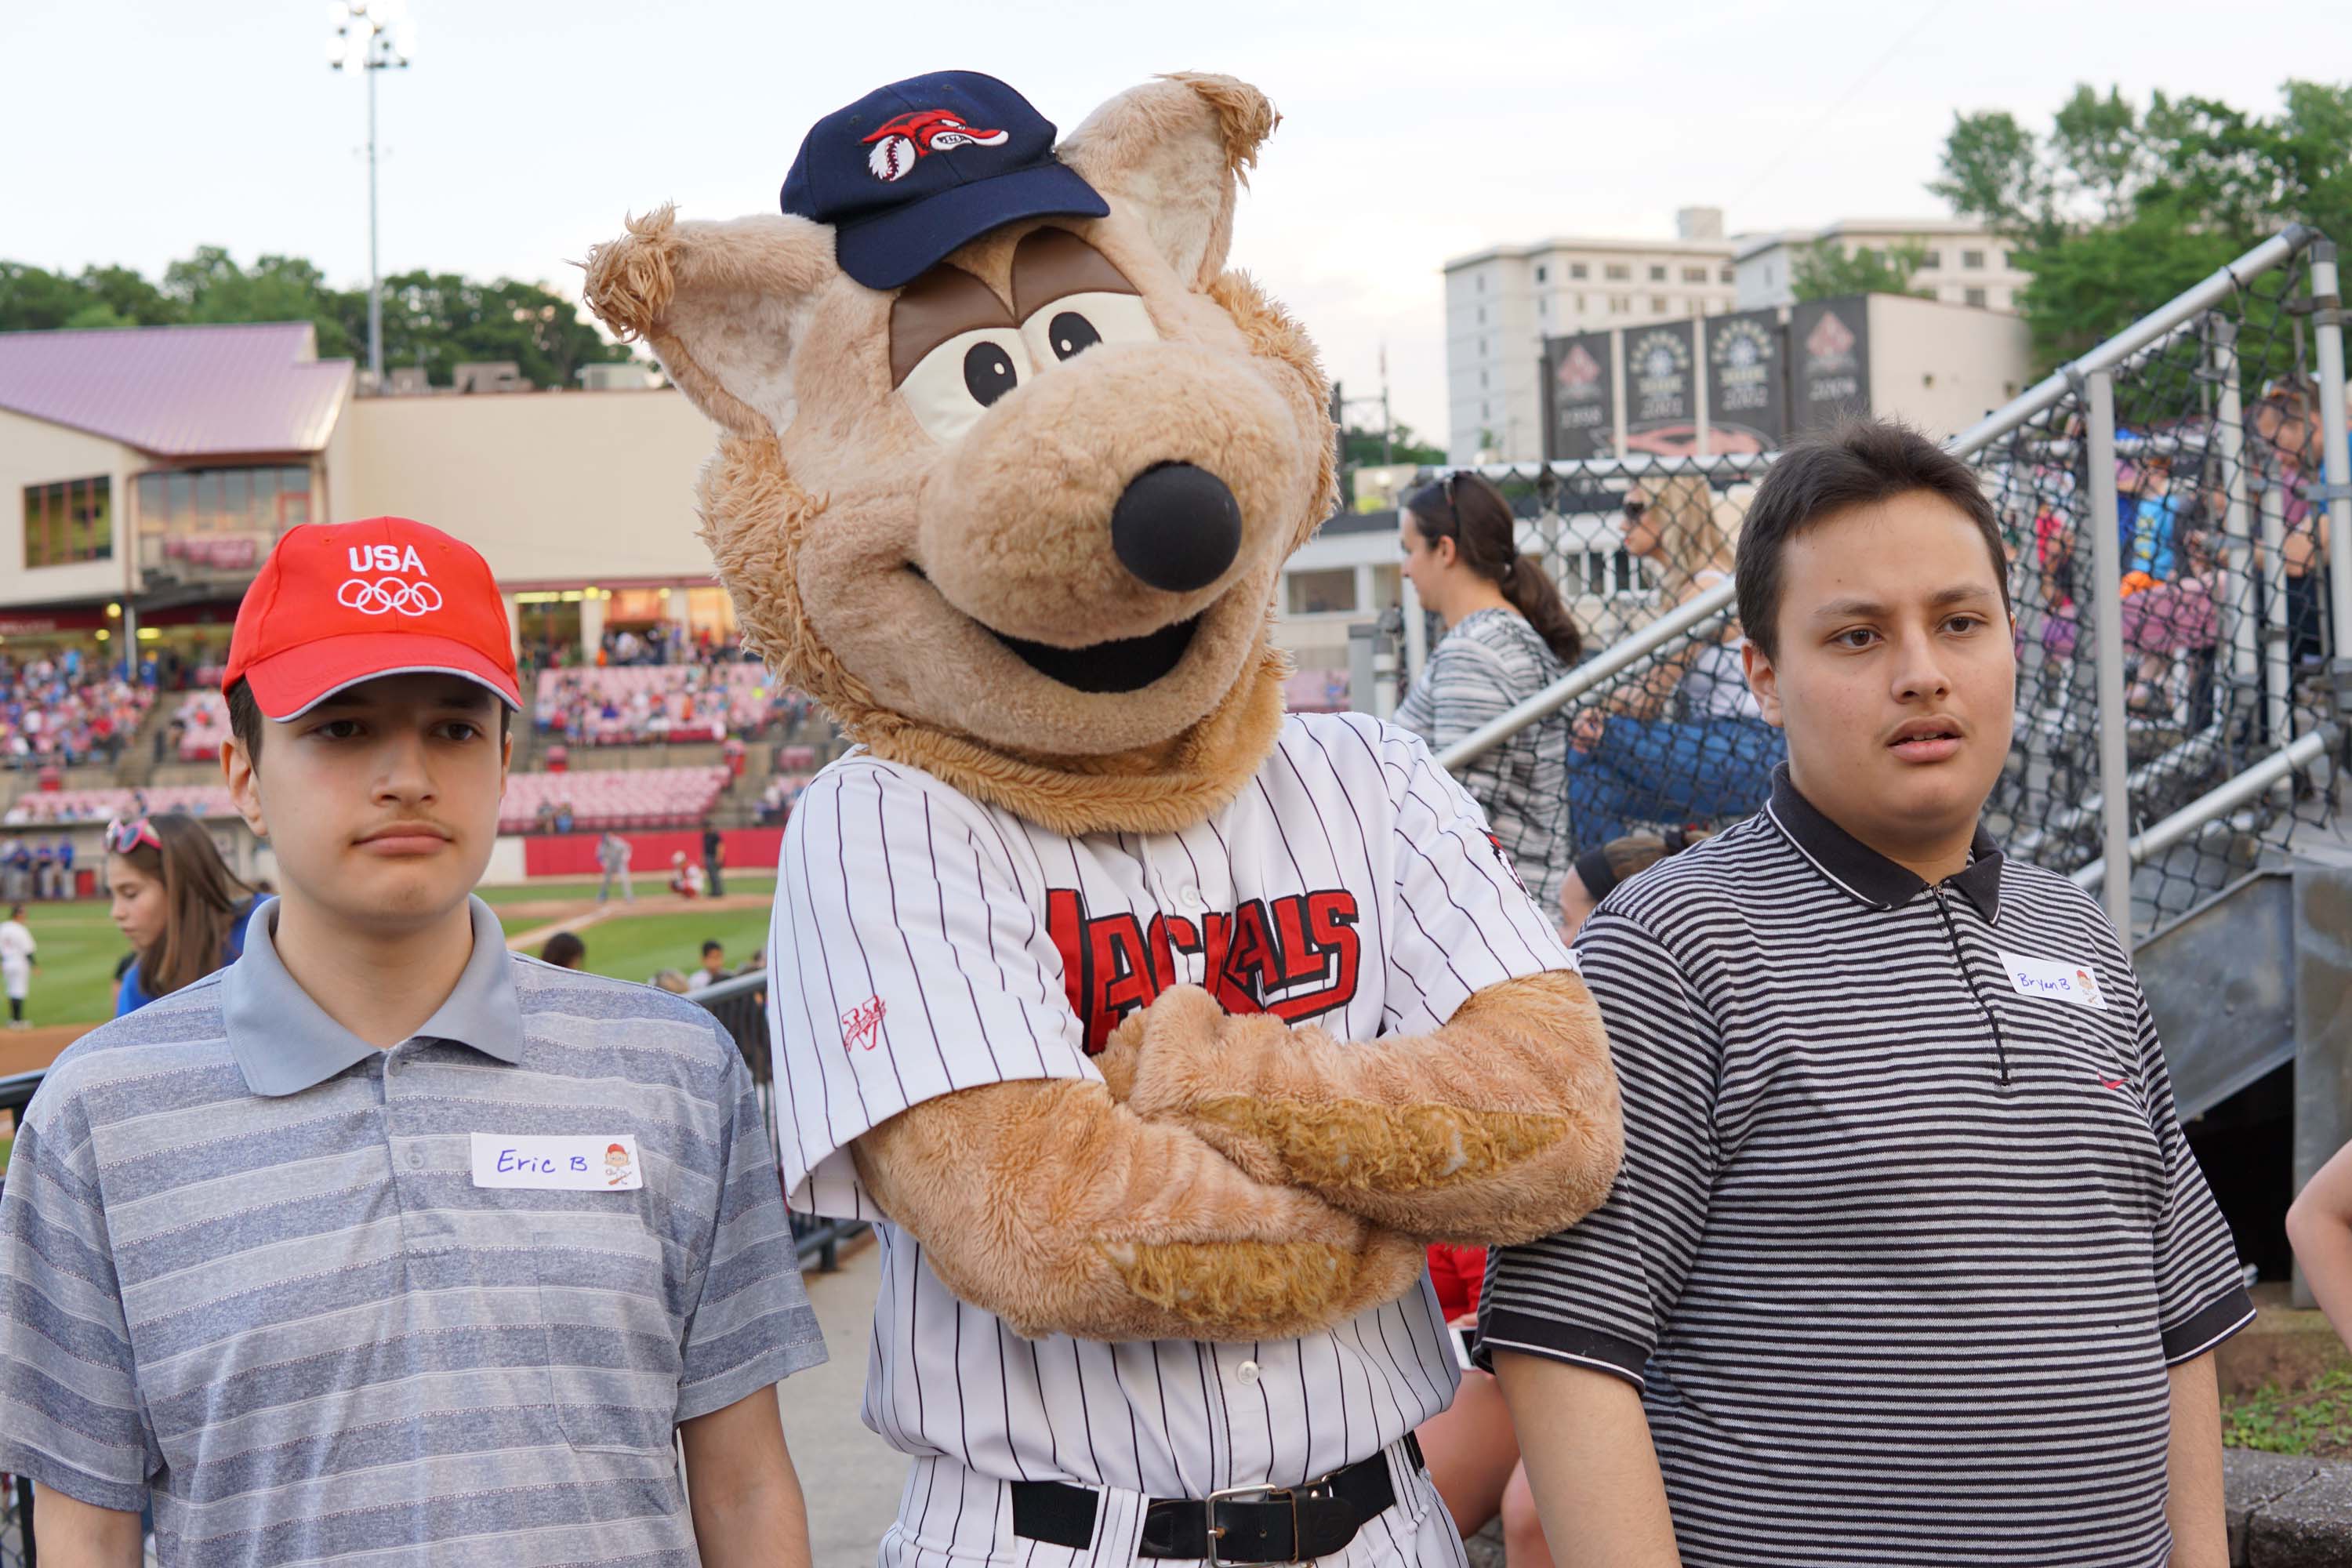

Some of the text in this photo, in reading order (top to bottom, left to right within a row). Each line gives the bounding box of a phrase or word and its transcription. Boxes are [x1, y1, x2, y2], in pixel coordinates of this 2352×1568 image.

[348, 545, 428, 576] USA
[2017, 973, 2071, 991] Bryan B
[497, 1149, 588, 1174] Eric B
